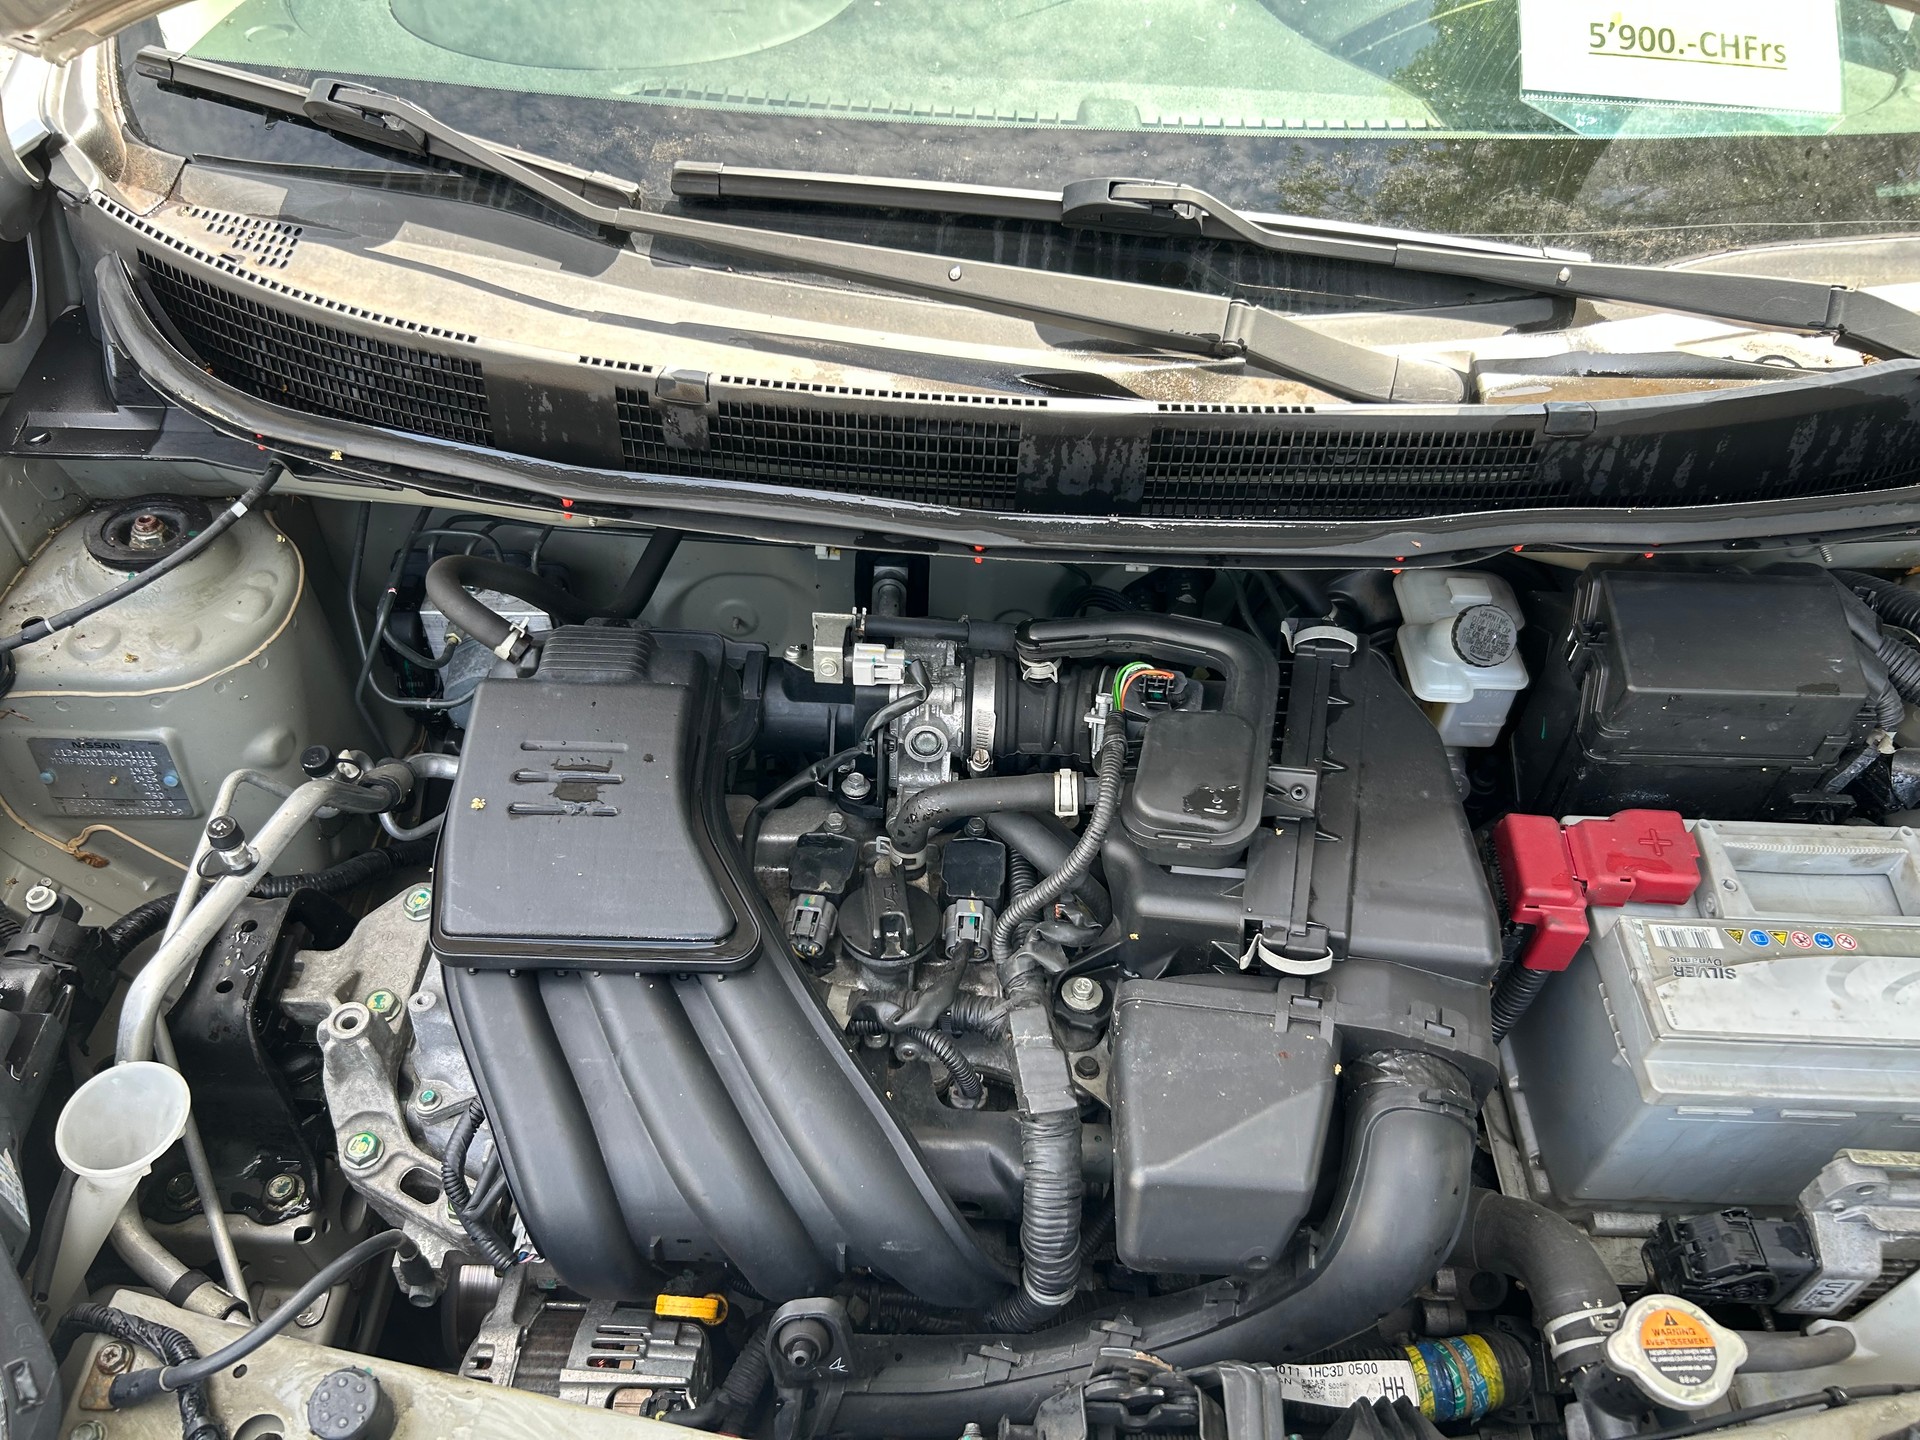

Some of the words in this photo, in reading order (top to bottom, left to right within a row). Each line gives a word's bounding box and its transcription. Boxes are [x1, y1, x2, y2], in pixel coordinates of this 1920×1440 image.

[71, 742, 121, 750] NISSAN
[1669, 956, 1722, 967] Dynamic
[1672, 965, 1736, 980] SILVER
[1652, 1327, 1697, 1337] WARNING
[1645, 1337, 1710, 1346] AVERTISSEMENT
[1308, 1366, 1344, 1378] 1HC3D
[1348, 1362, 1379, 1376] 0500
